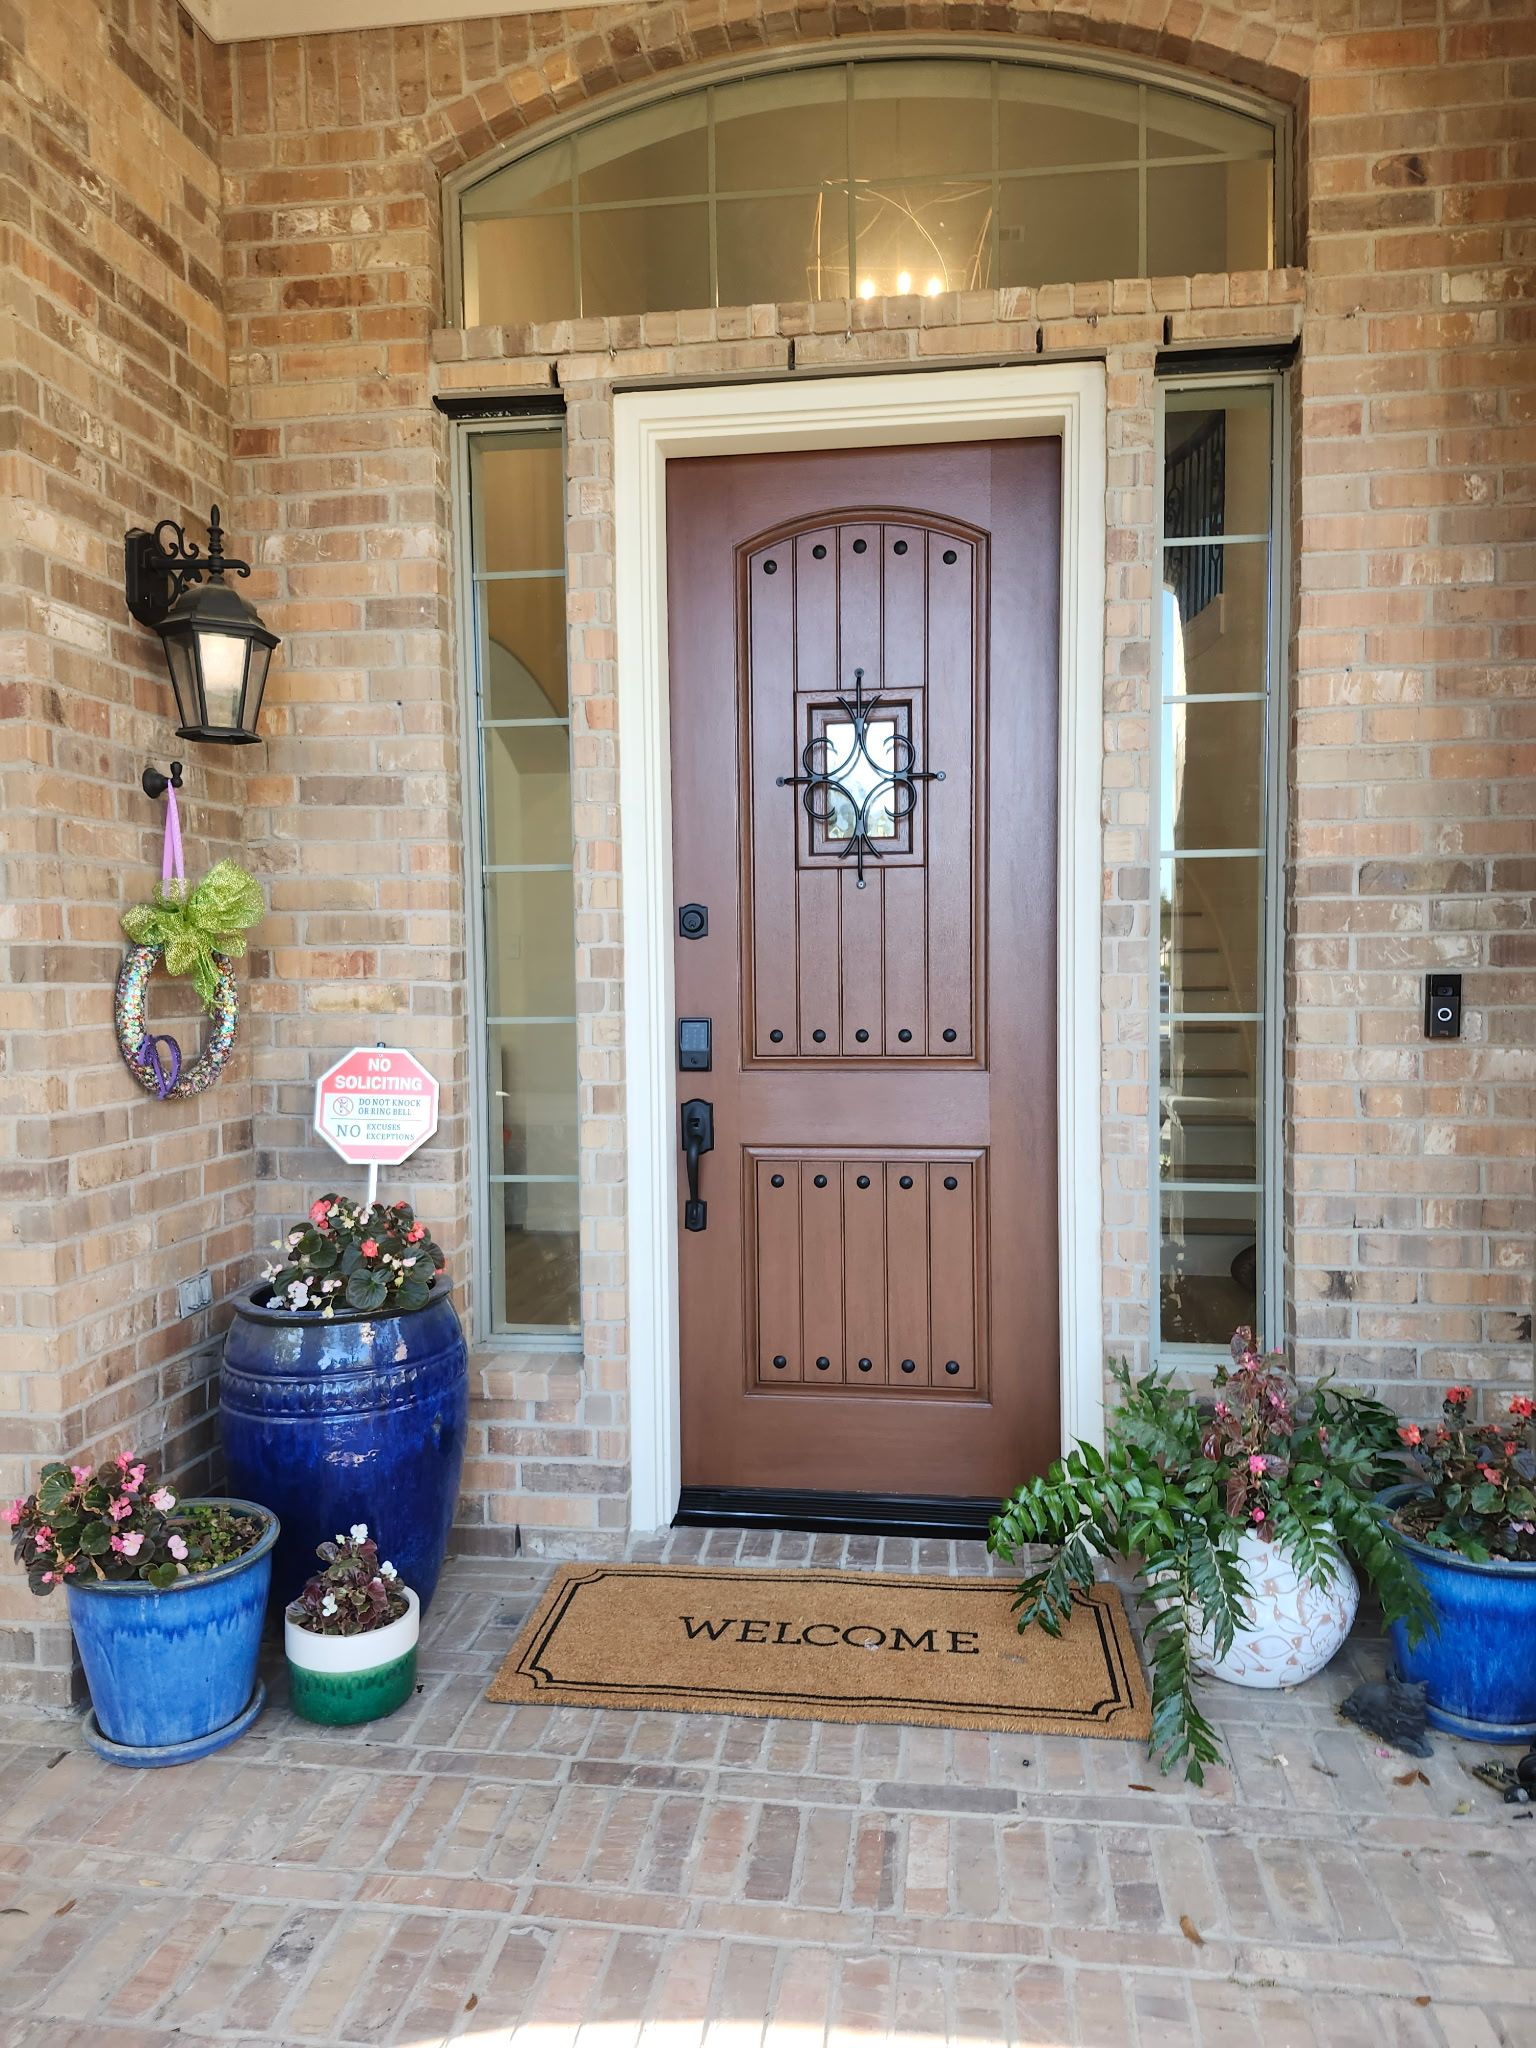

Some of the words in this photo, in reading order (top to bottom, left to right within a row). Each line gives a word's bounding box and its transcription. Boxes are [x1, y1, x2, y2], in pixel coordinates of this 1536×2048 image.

[368, 1058, 392, 1072] NO
[335, 1076, 423, 1091] SOLICITING
[359, 1098, 372, 1106] DO
[392, 1099, 421, 1107] KNOCK
[371, 1108, 391, 1116] RING
[393, 1108, 412, 1116] BELL
[336, 1124, 361, 1138] NO
[366, 1123, 401, 1131] EXCUSES
[366, 1133, 415, 1141] EXCEPTIONS
[679, 1616, 980, 1654] WELCOME
